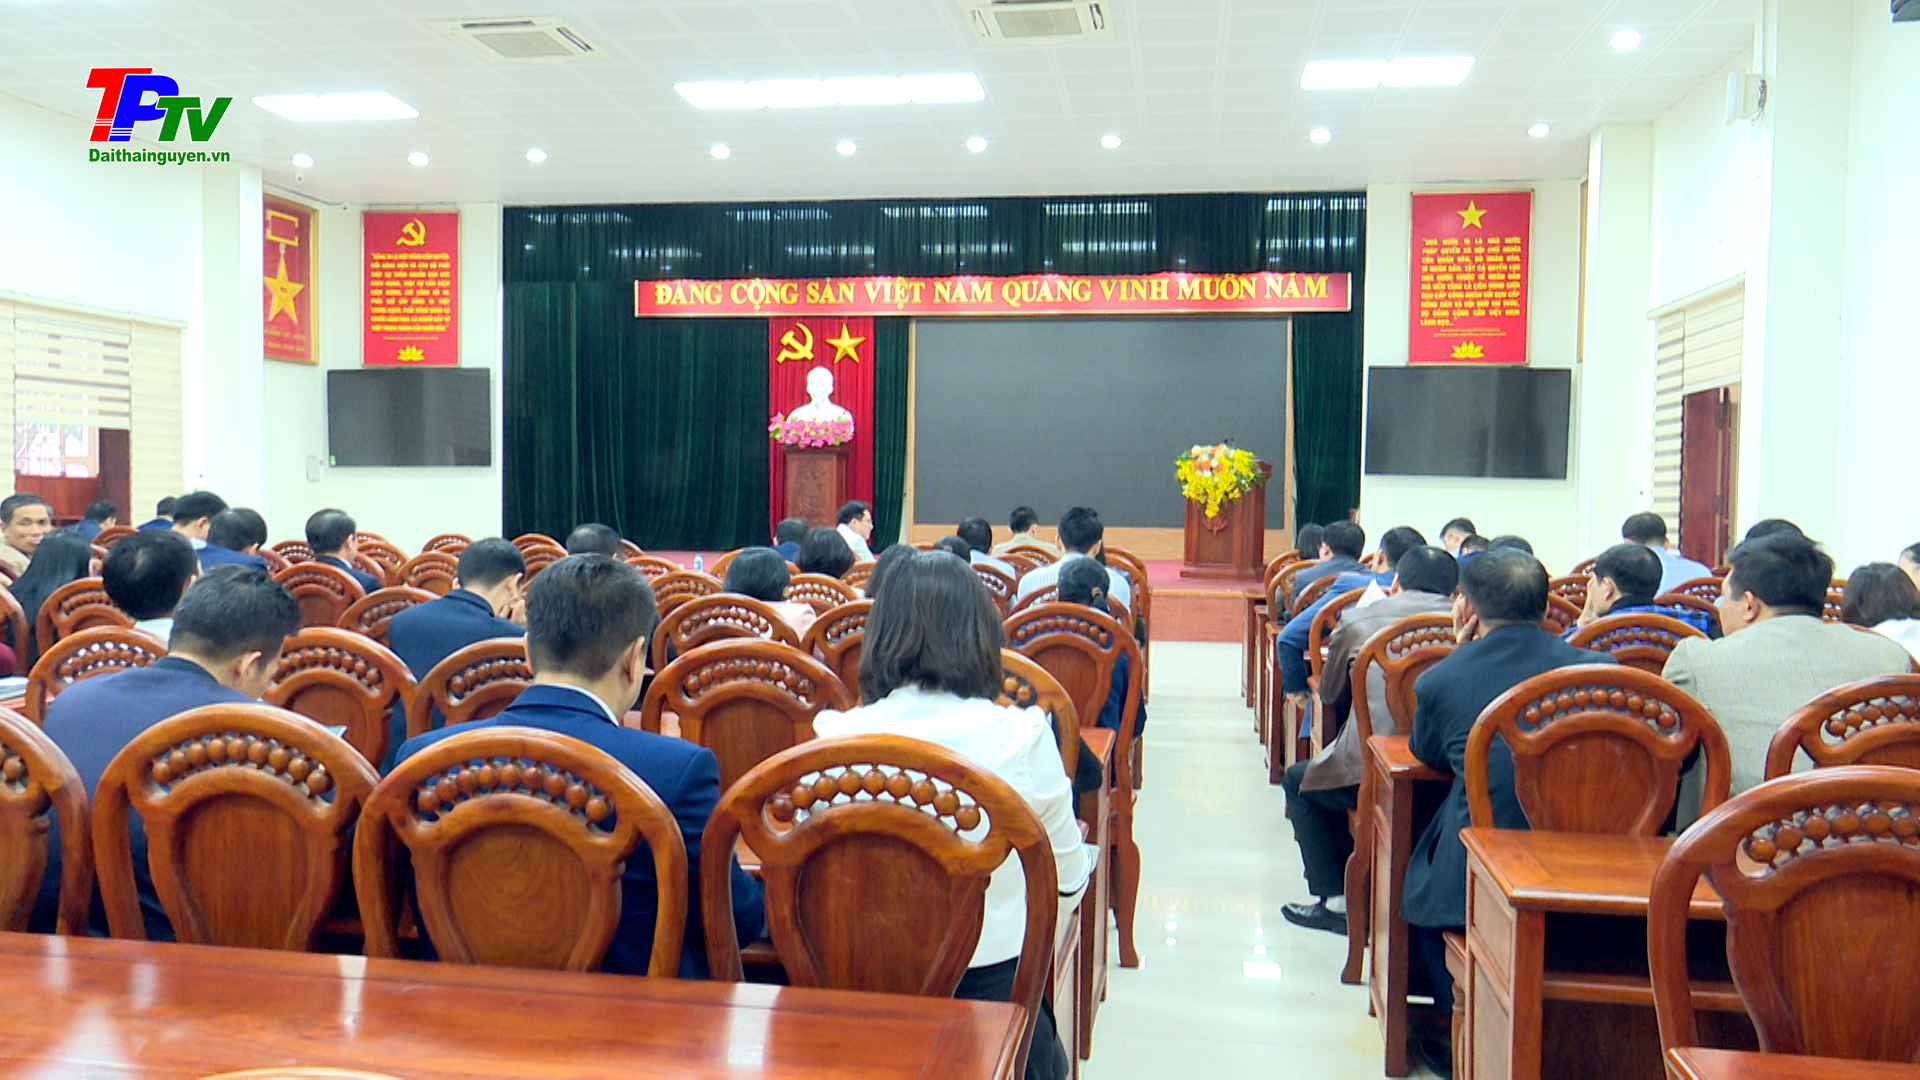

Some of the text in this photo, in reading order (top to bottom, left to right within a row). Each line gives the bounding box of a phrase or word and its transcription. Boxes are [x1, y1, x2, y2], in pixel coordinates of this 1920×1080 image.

[654, 274, 1328, 310] ĐẢNG CỘNG SẢN VIỆT NAM QUANG VINH MUÔN NĂM
